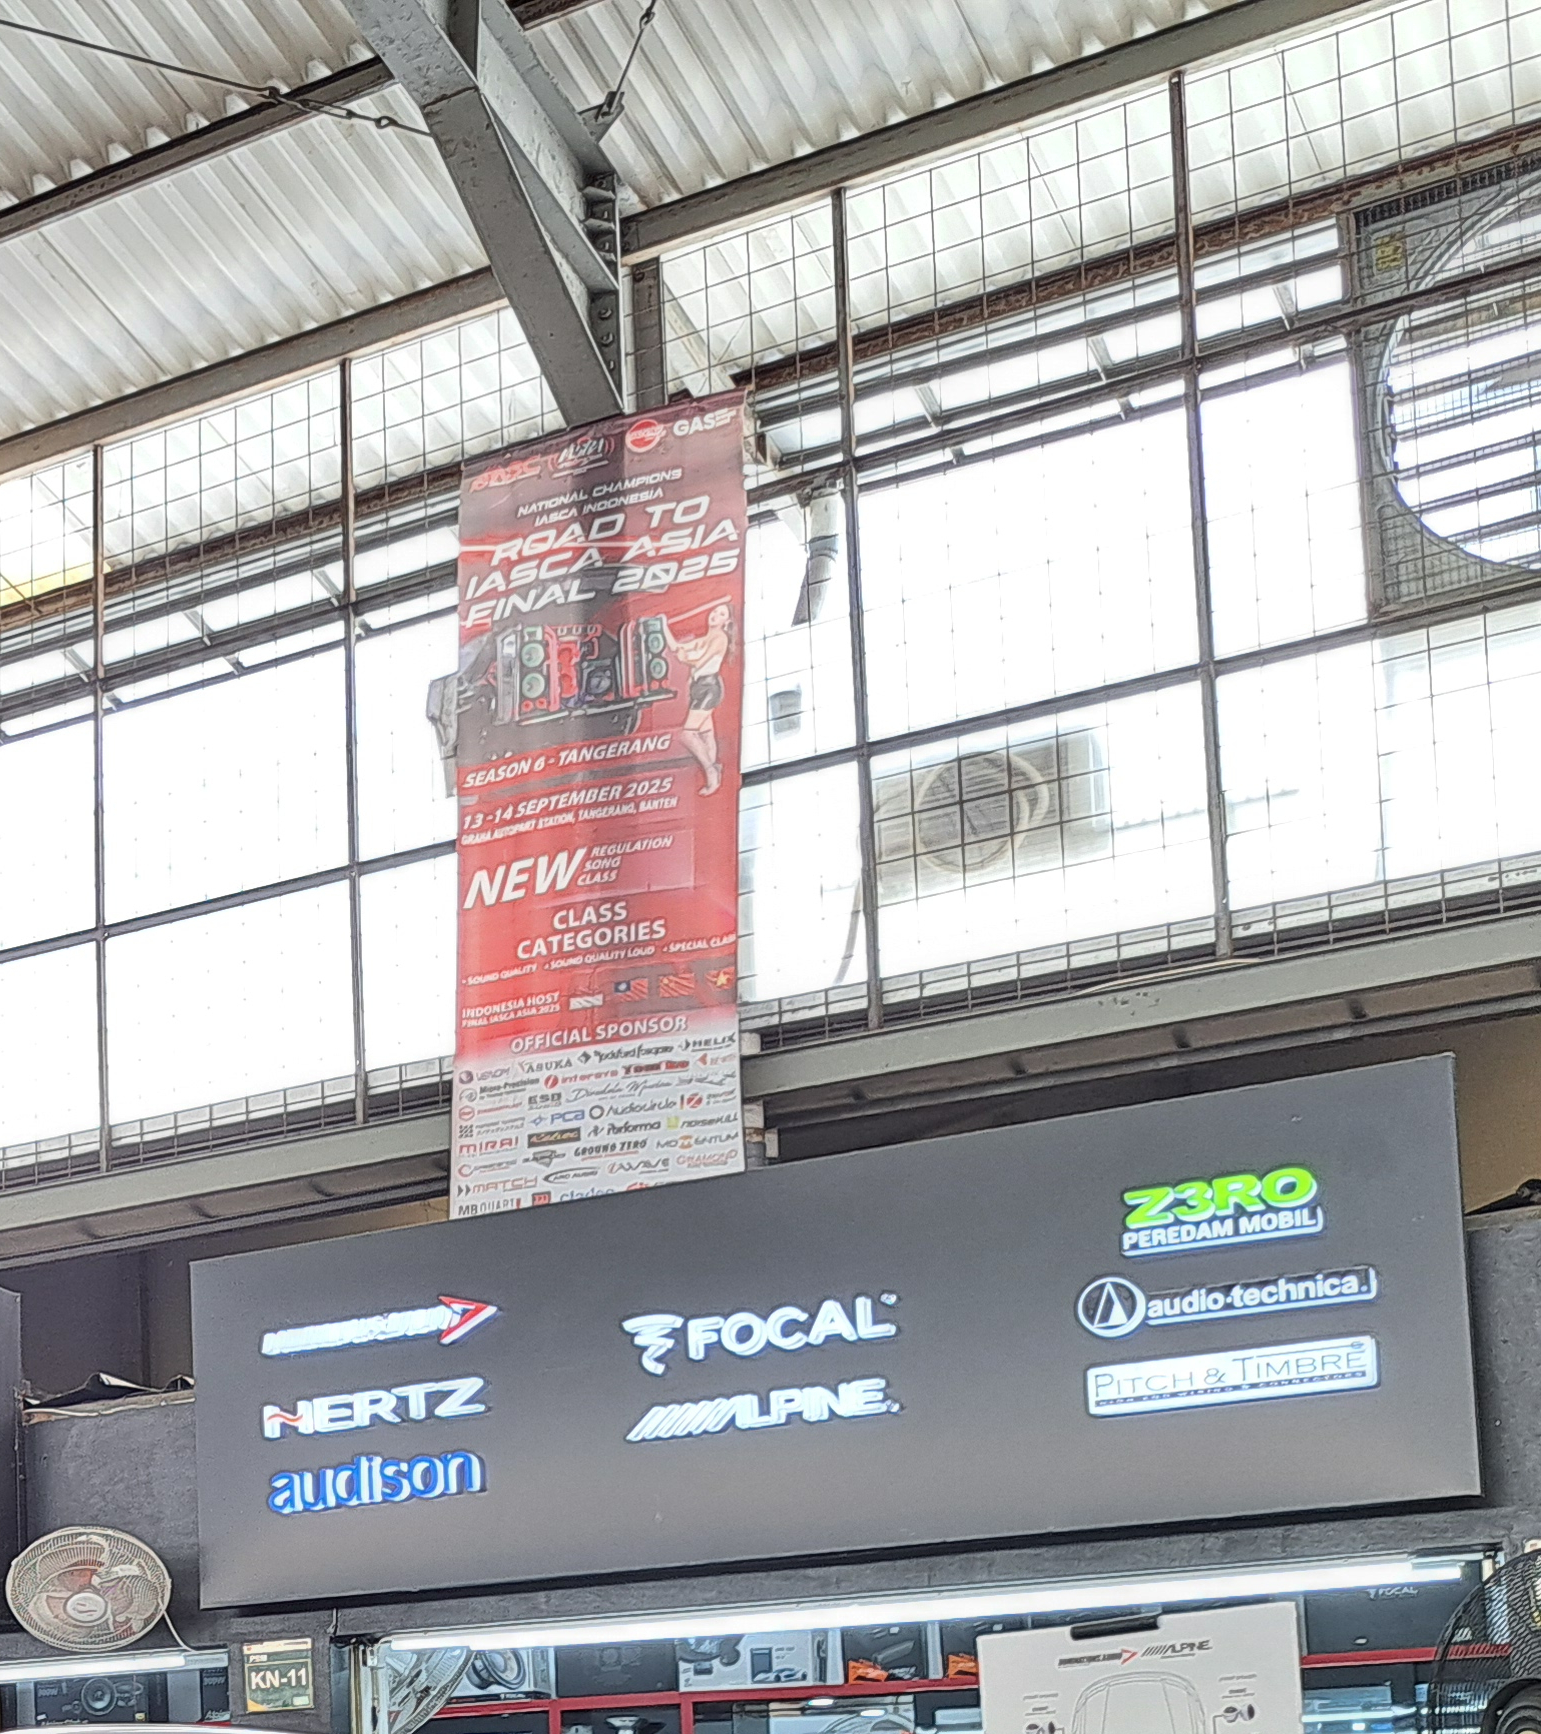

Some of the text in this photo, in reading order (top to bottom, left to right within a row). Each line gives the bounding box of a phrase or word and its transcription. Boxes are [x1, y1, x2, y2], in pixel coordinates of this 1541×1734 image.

[517, 468, 682, 517] NATIONAL CHAMPIONS
[490, 495, 710, 566] ROAD TO
[534, 508, 578, 527] IASCA
[465, 518, 740, 600] IASCA ASIA
[465, 548, 740, 628] FINAL 2025
[463, 734, 672, 788] SEASON 6 TANGERANG
[463, 814, 483, 830] 13
[517, 783, 627, 816] SEPTEMBER
[628, 777, 674, 799] 2025
[590, 835, 674, 858] REGULATION
[462, 846, 587, 909] NEW
[576, 870, 618, 887] CLASS
[516, 919, 666, 960] CATEGORIES
[553, 902, 628, 930] CLASS
[462, 992, 560, 1019] INDONESIA HOST
[511, 1015, 688, 1054] OFFICIAL SPONSOR
[1122, 1167, 1318, 1229] Z3RO
[1122, 1206, 1317, 1251] PEREDAM MOBIL
[686, 1296, 898, 1362] FOCAL
[1203, 1368, 1226, 1385] &
[262, 1376, 487, 1440] HERTZ
[268, 1451, 487, 1515] audison
[250, 1667, 307, 1690] KN-11
